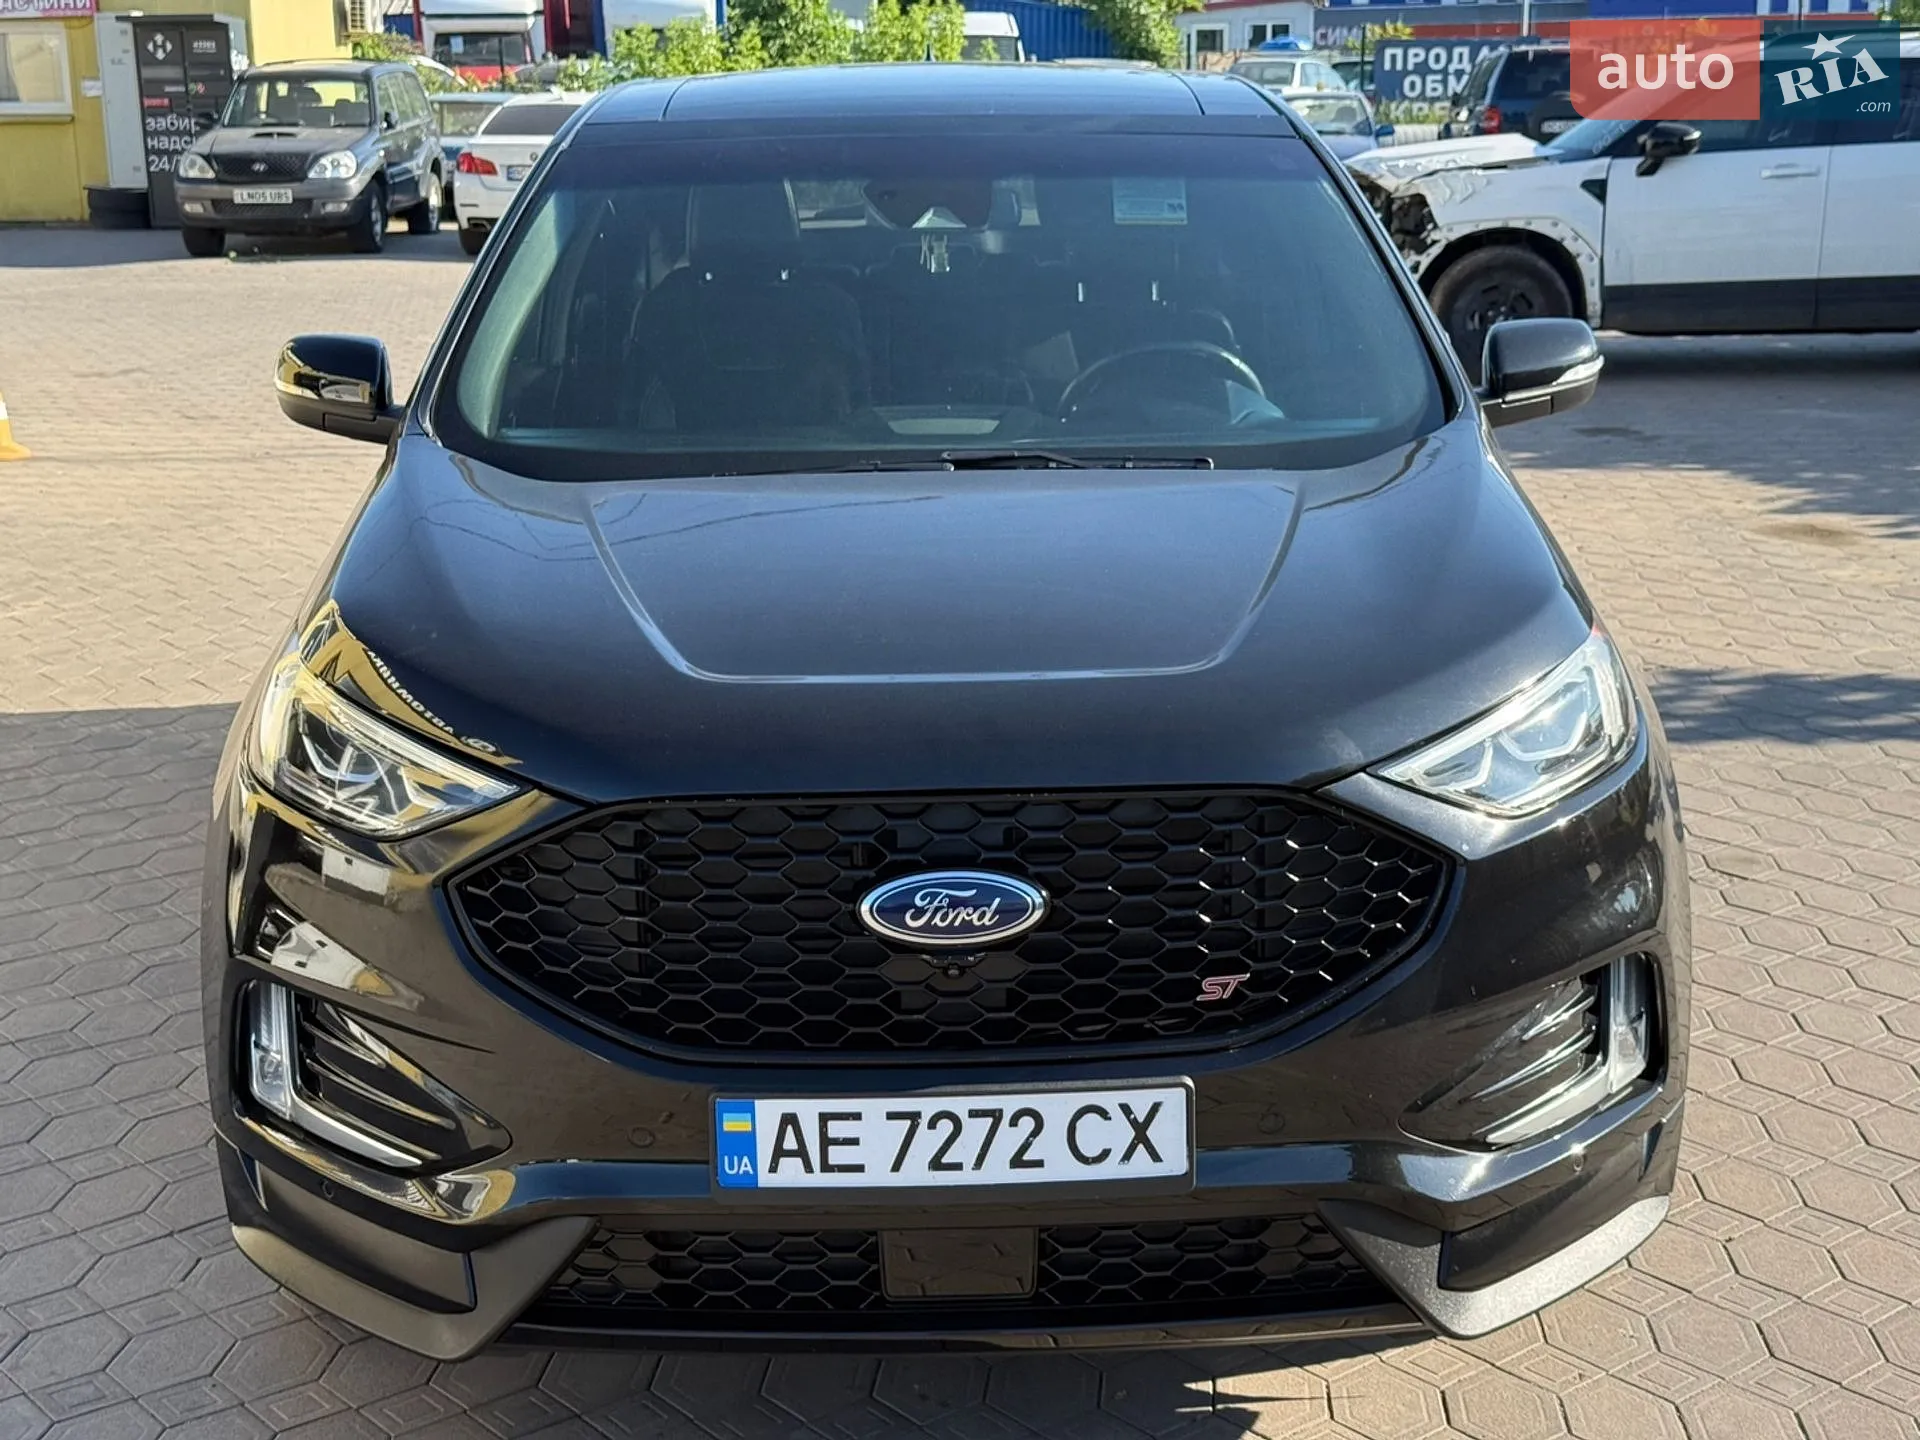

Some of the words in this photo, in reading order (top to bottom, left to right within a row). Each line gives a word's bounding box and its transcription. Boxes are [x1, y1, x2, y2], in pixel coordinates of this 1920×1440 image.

[905, 888, 1000, 927] Ford
[1197, 973, 1250, 1001] ST
[768, 1111, 866, 1174] AE
[885, 1107, 1046, 1173] 7272
[1066, 1101, 1164, 1166] CX
[724, 1155, 754, 1176] UA
